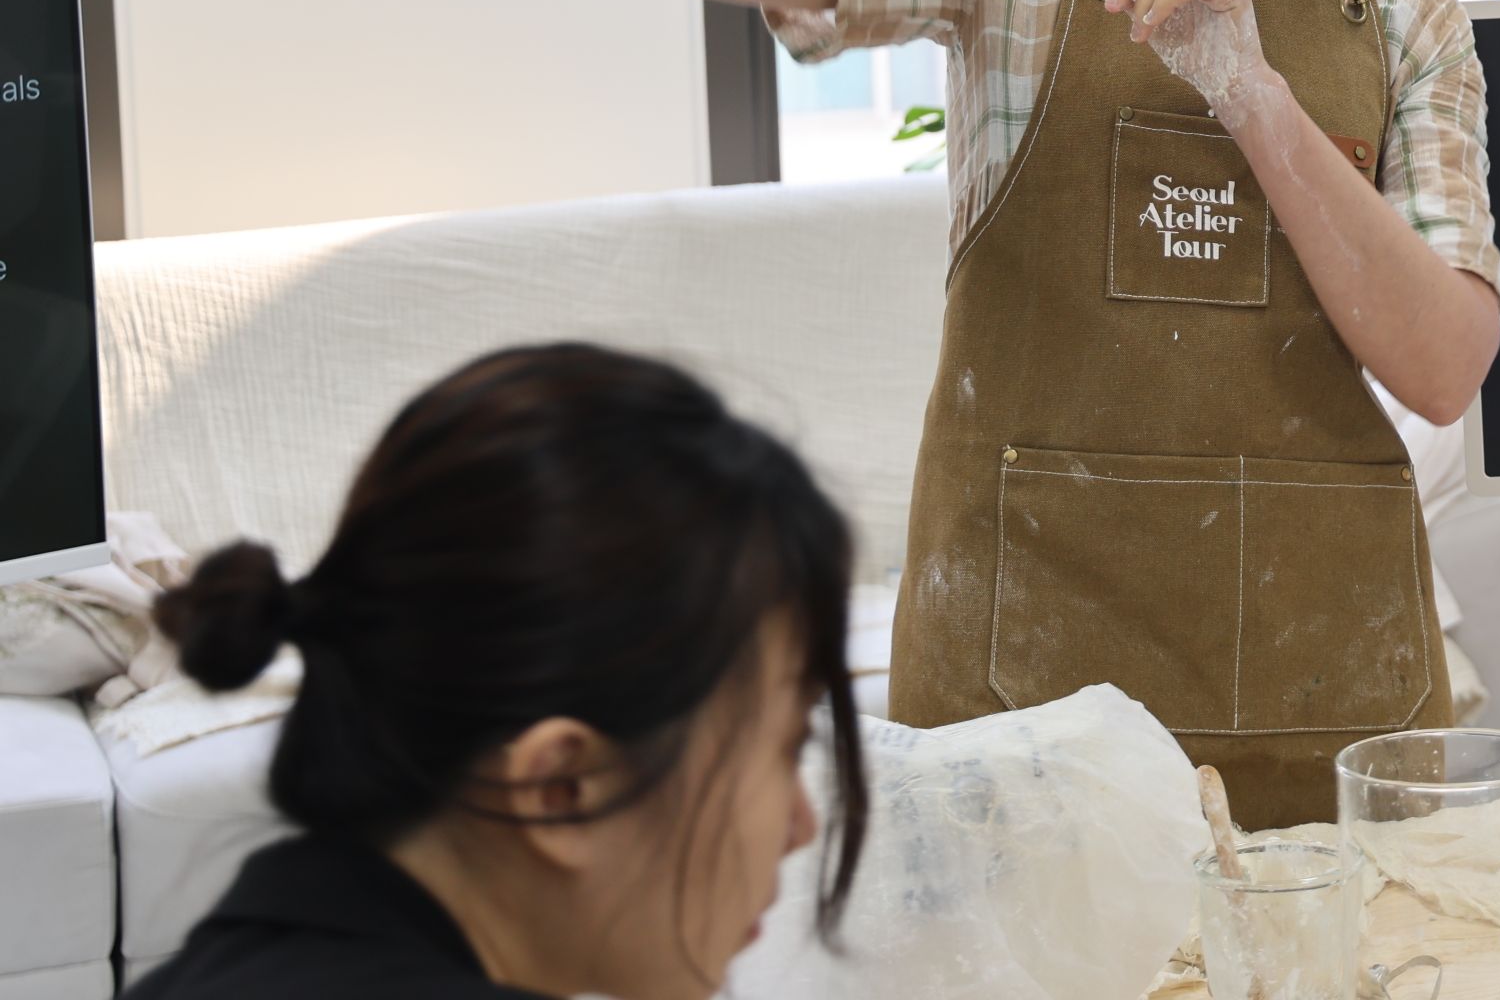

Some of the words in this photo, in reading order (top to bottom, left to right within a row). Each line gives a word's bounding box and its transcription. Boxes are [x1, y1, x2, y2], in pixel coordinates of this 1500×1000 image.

[2, 75, 40, 102] als
[1152, 175, 1235, 205] Seoul
[1139, 202, 1243, 234] Atelier
[1157, 230, 1226, 260] Tour
